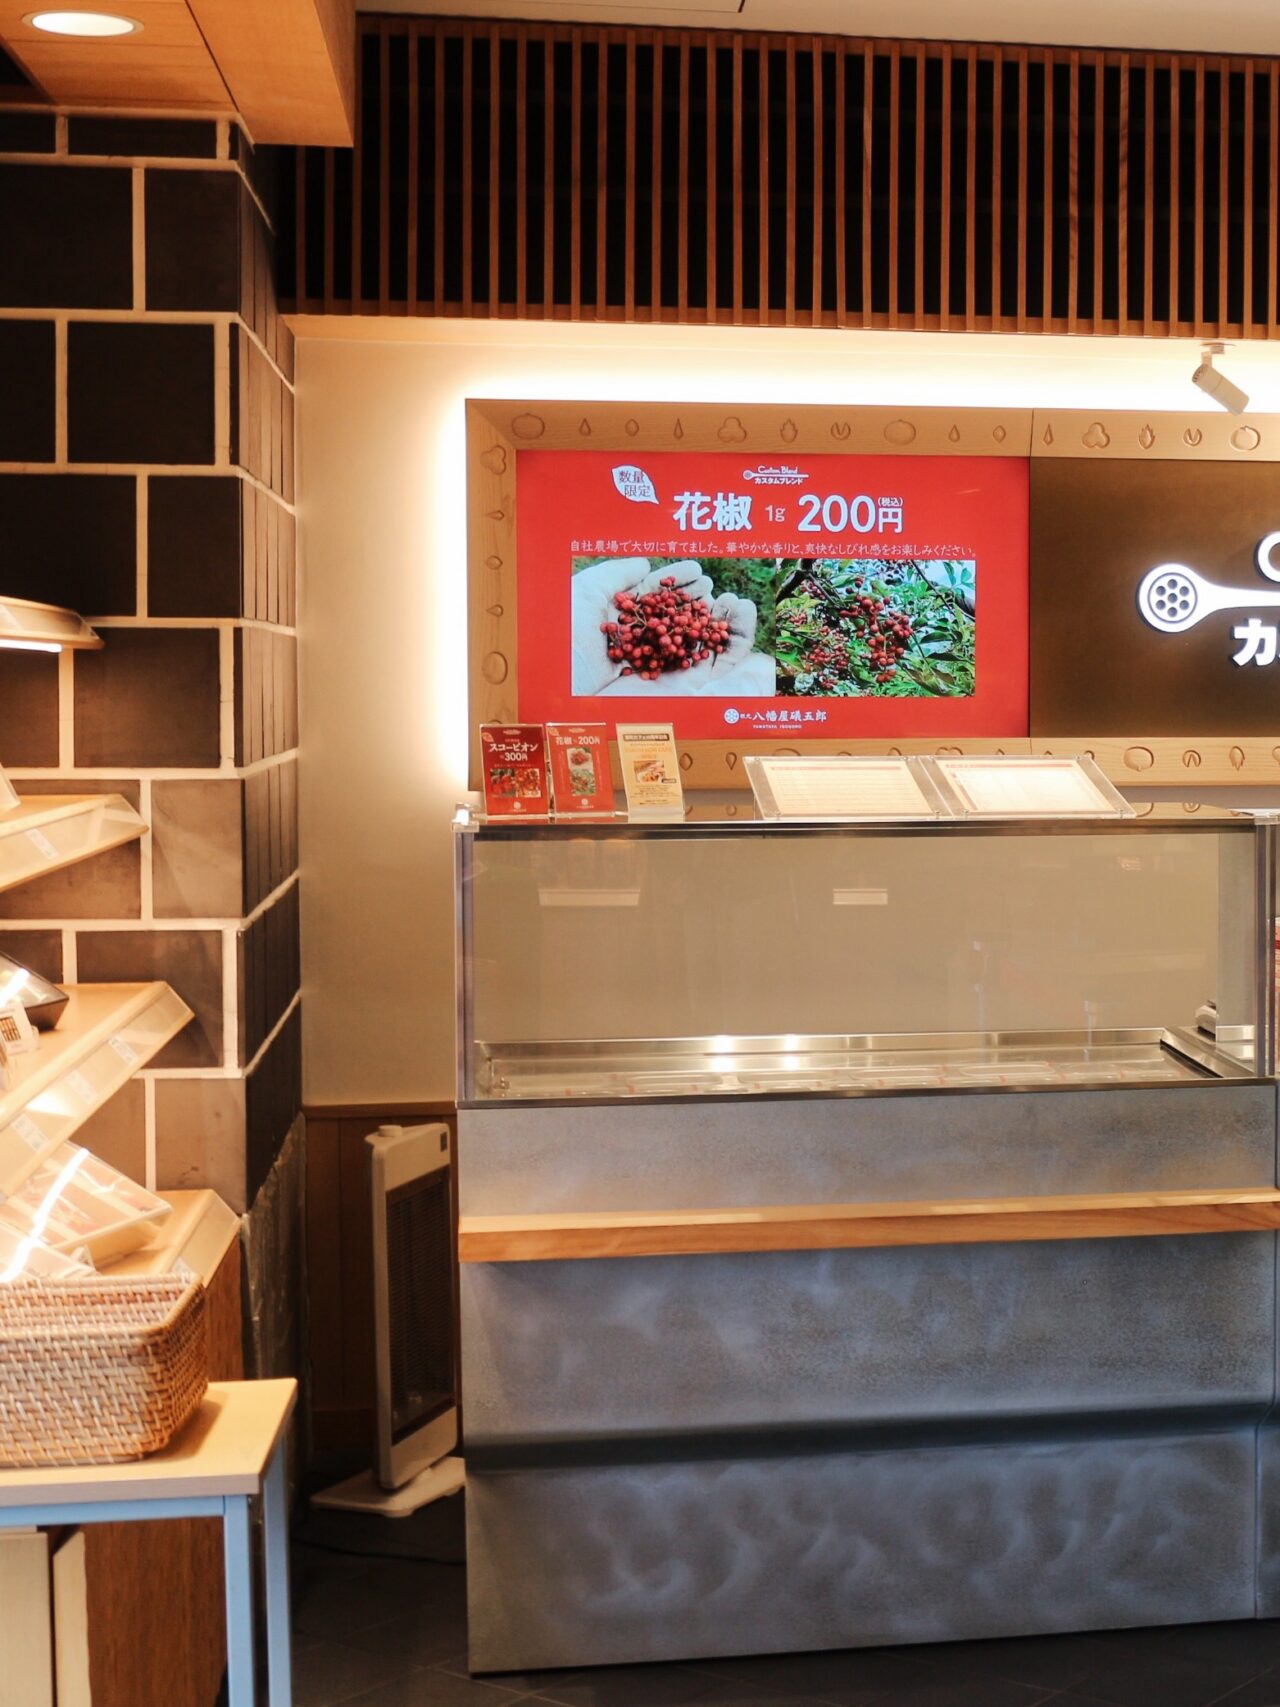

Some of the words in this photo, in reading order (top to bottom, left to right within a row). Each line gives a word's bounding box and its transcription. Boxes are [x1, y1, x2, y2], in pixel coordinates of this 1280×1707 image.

[618, 470, 645, 484] 数量
[754, 477, 804, 486] カスタムブレンド
[623, 484, 652, 498] 限定
[672, 491, 753, 532] 花椒
[764, 504, 786, 523] 1g
[797, 493, 904, 533] 200円
